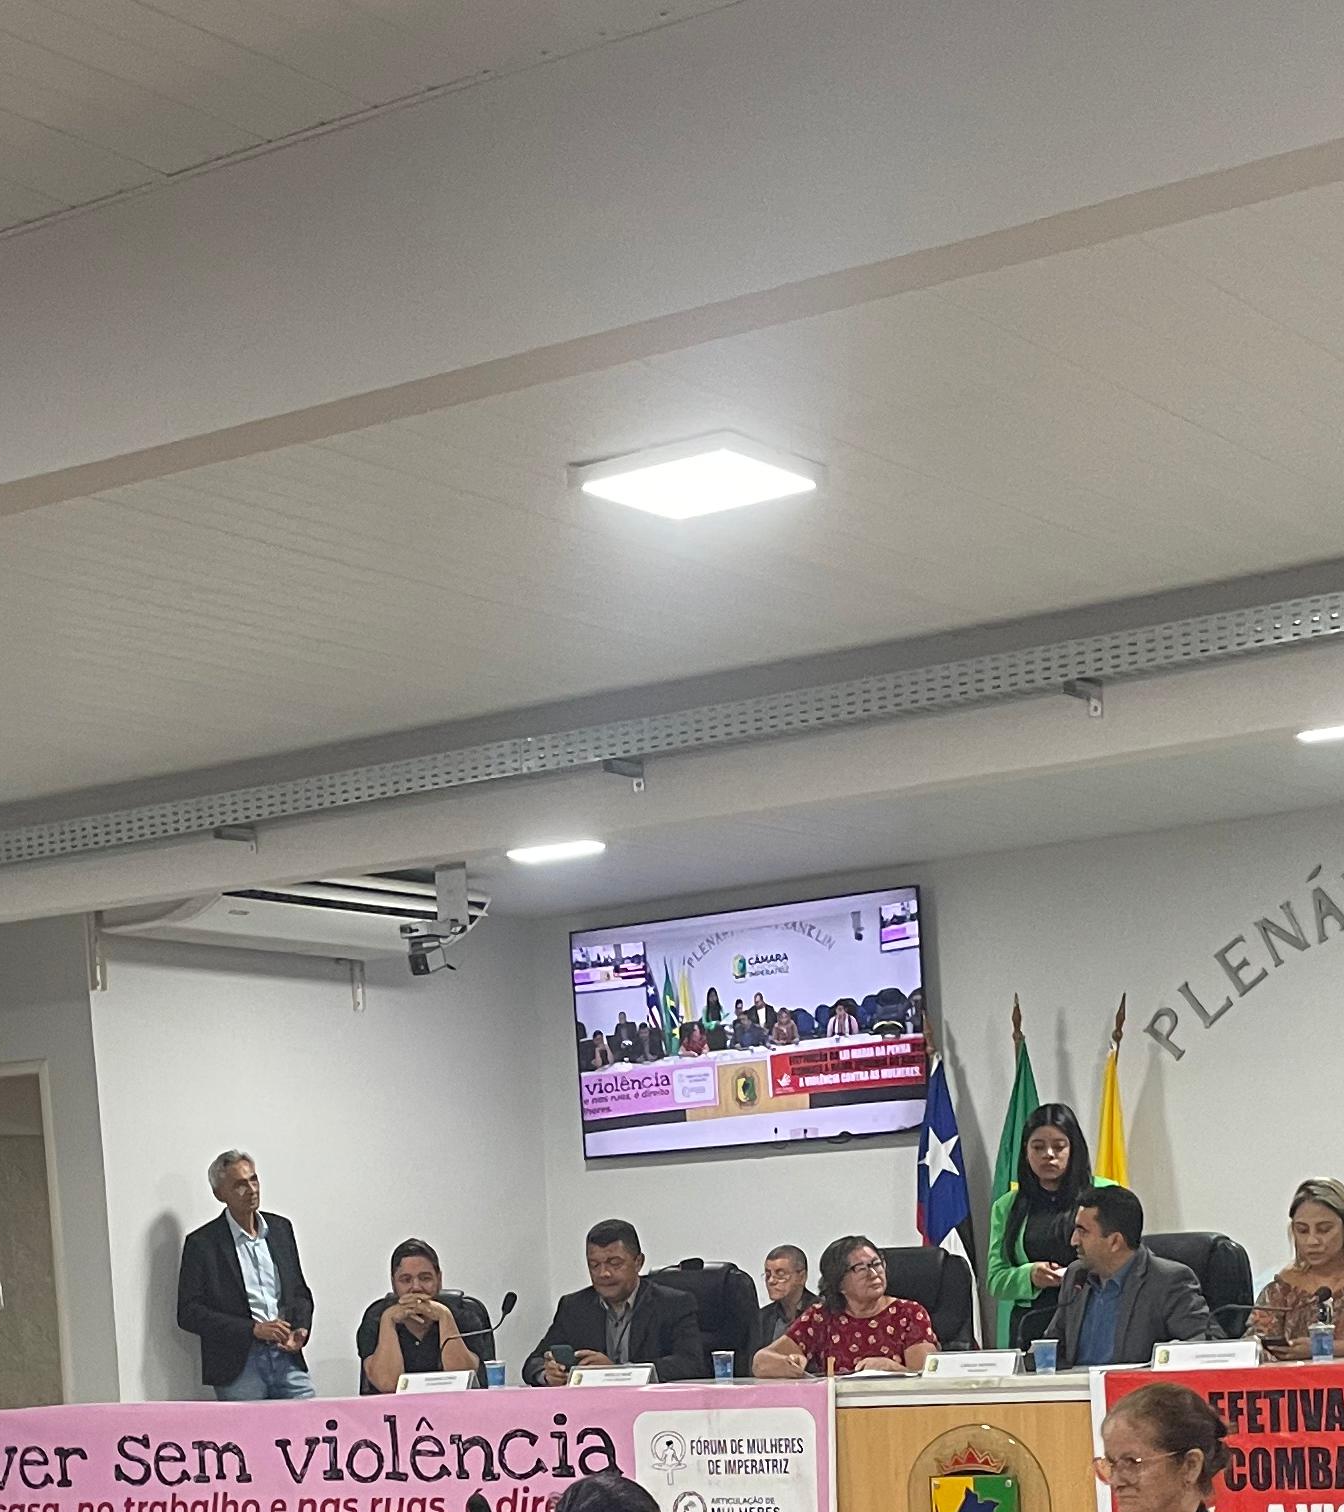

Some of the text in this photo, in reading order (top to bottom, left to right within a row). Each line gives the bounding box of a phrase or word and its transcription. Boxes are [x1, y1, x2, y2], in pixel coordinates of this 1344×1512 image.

[584, 1072, 672, 1096] violência
[113, 1432, 253, 1487] Sem
[274, 1413, 624, 1485] violência
[690, 1436, 804, 1456] FÓRUM DE MULHERES
[708, 1458, 790, 1475] DE IMPERATRIZ
[710, 1495, 776, 1506] ARTICULAÇÃO DE
